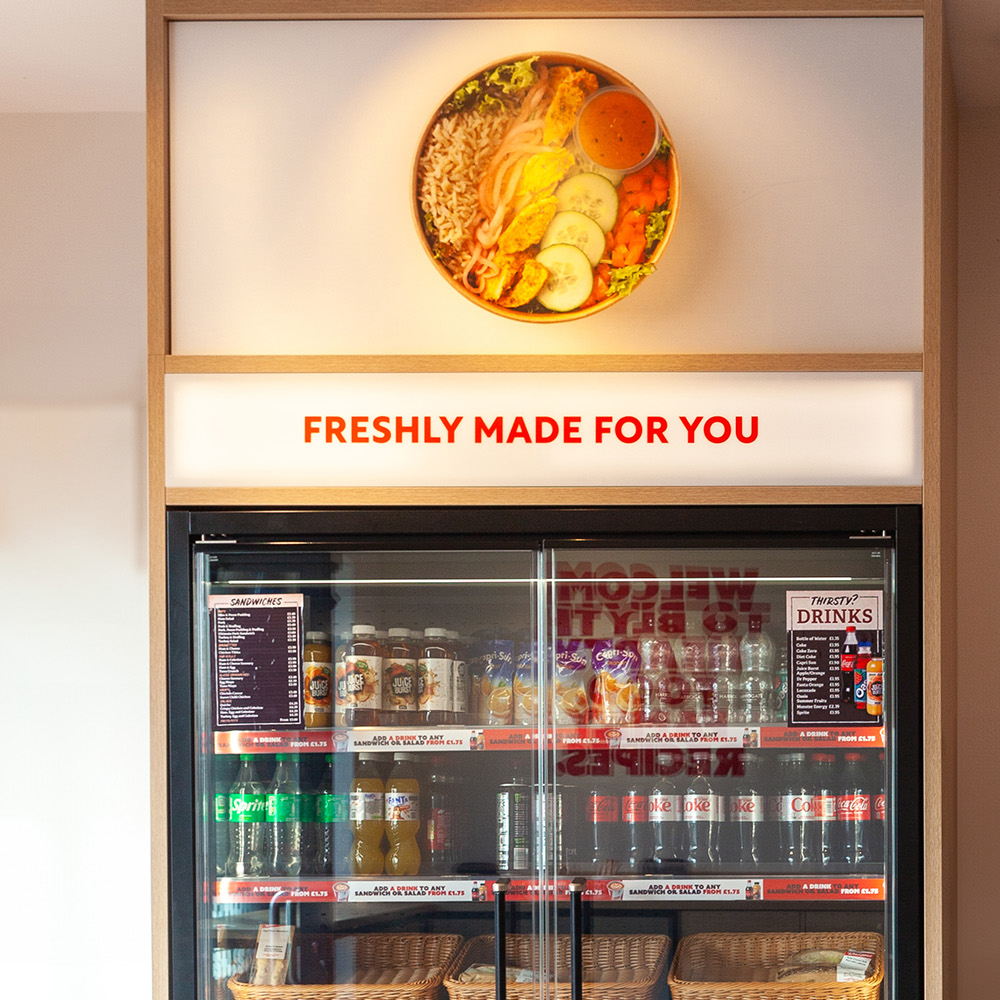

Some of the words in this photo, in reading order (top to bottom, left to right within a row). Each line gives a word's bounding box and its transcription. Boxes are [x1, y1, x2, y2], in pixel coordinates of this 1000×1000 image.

[304, 415, 463, 444] FRESHLY
[474, 415, 582, 444] MADE
[595, 415, 668, 445] FOR
[679, 415, 759, 445] YOU
[230, 597, 282, 607] SANDWICHES
[810, 593, 859, 606] THIRSTY?
[796, 608, 873, 624] DRINKS
[556, 651, 588, 666] pri-Sun
[595, 649, 639, 662] Capri-Sun
[310, 680, 329, 690] JUICE
[347, 674, 364, 685] JUICE
[392, 677, 412, 688] JUICE
[348, 682, 364, 692] BURST
[394, 686, 412, 694] BURST
[311, 690, 328, 698] BURST
[232, 798, 268, 814] Sprite
[388, 796, 409, 805] FANTA
